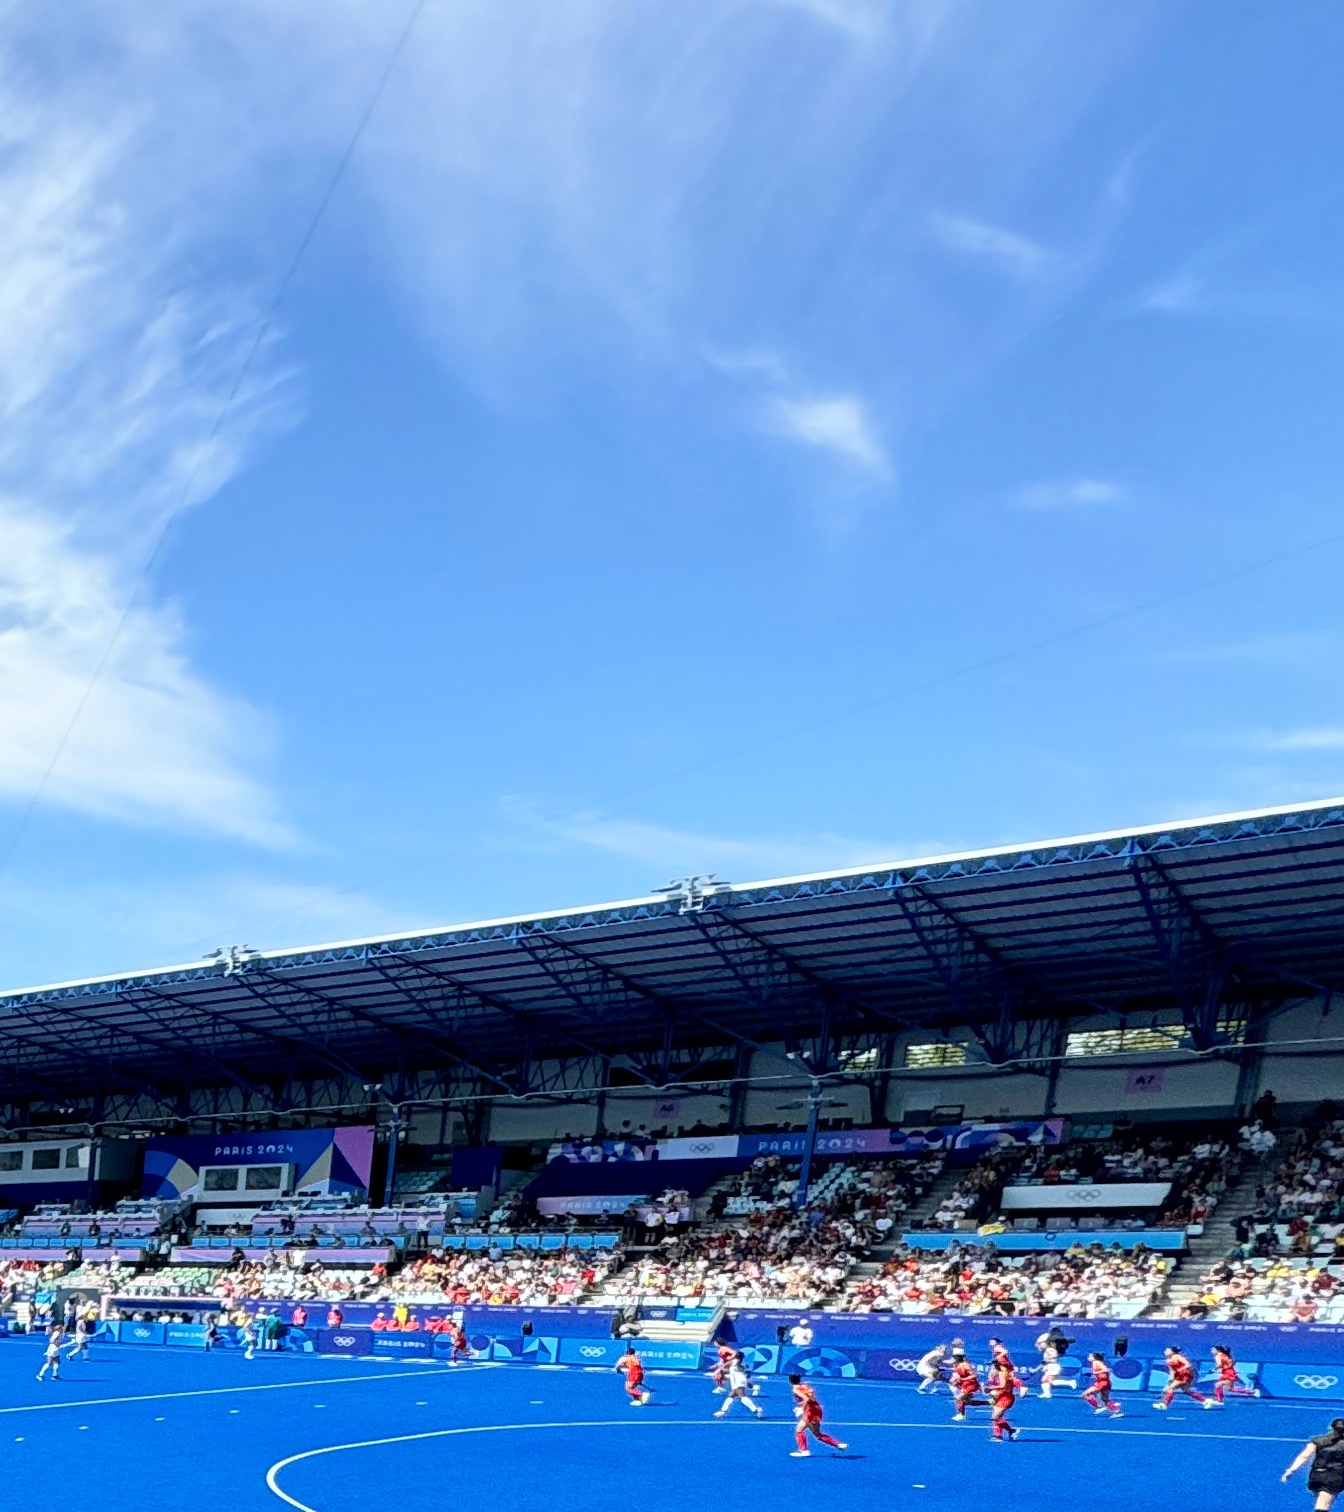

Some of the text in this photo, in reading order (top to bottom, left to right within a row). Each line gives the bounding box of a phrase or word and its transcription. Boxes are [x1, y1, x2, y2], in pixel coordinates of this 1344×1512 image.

[214, 1144, 293, 1156] PARIS 2024
[816, 1138, 866, 1150] 2024
